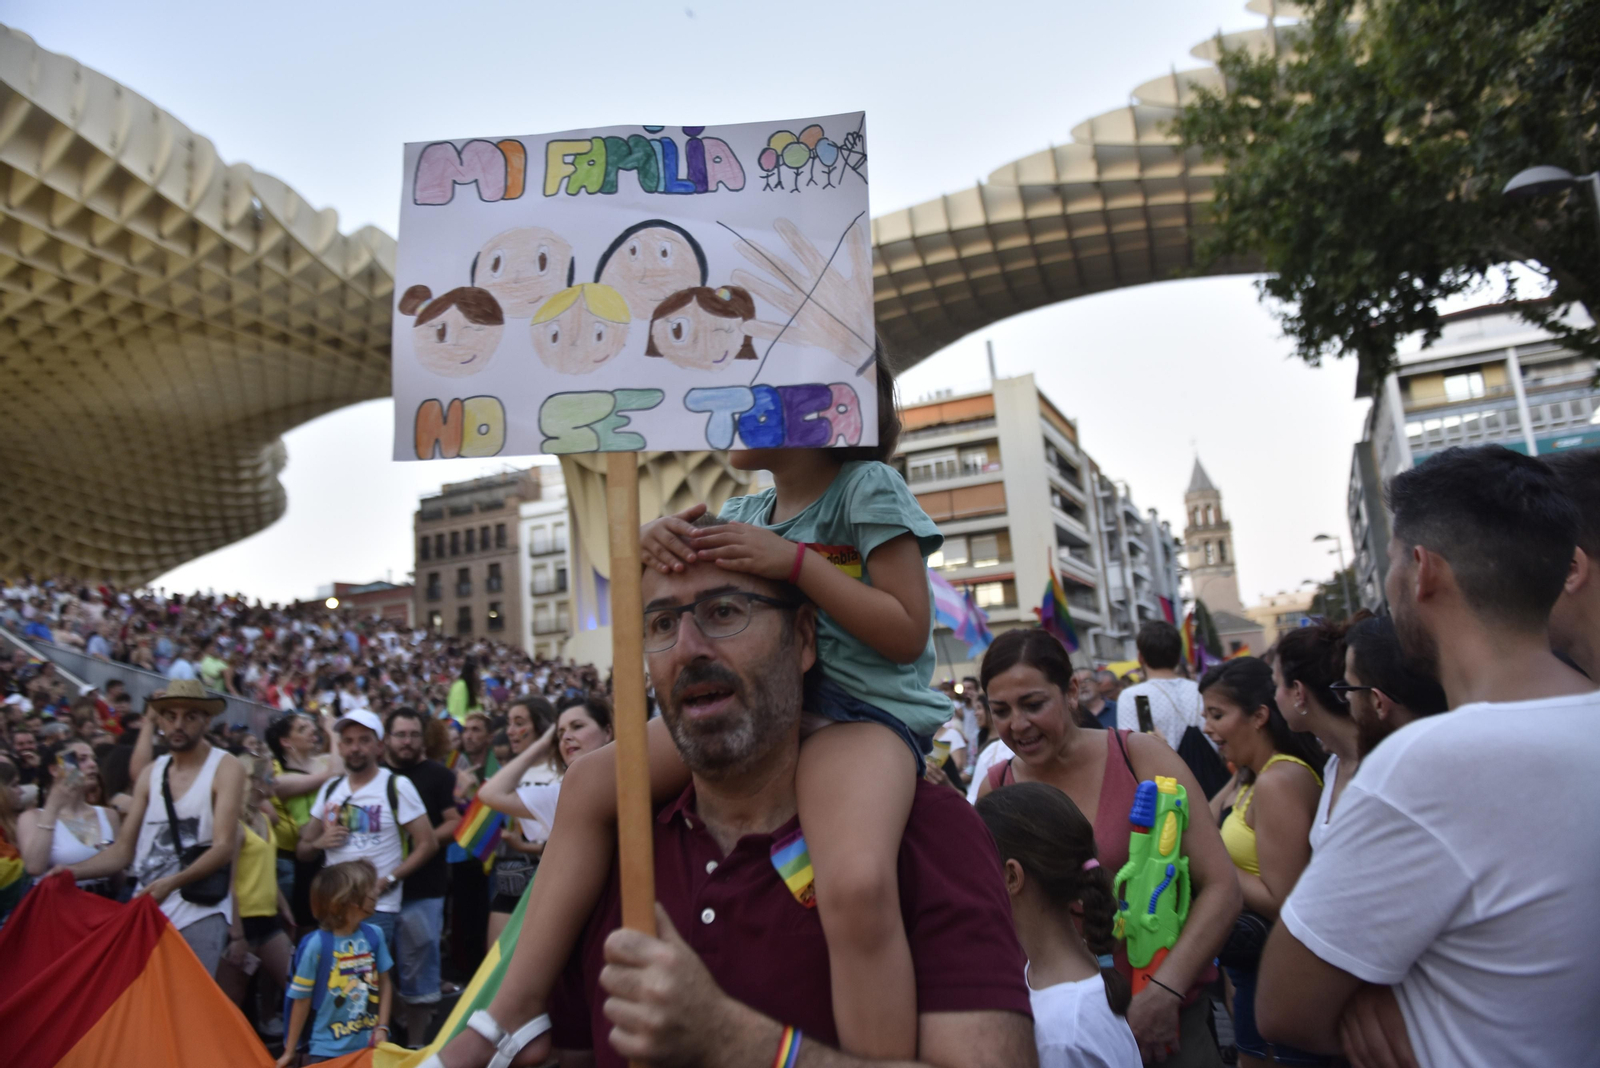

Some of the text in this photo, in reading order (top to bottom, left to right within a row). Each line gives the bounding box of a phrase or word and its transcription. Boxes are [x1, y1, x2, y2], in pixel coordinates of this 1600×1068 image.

[413, 138, 527, 206] MI
[414, 382, 863, 460] NO SE TOCA
